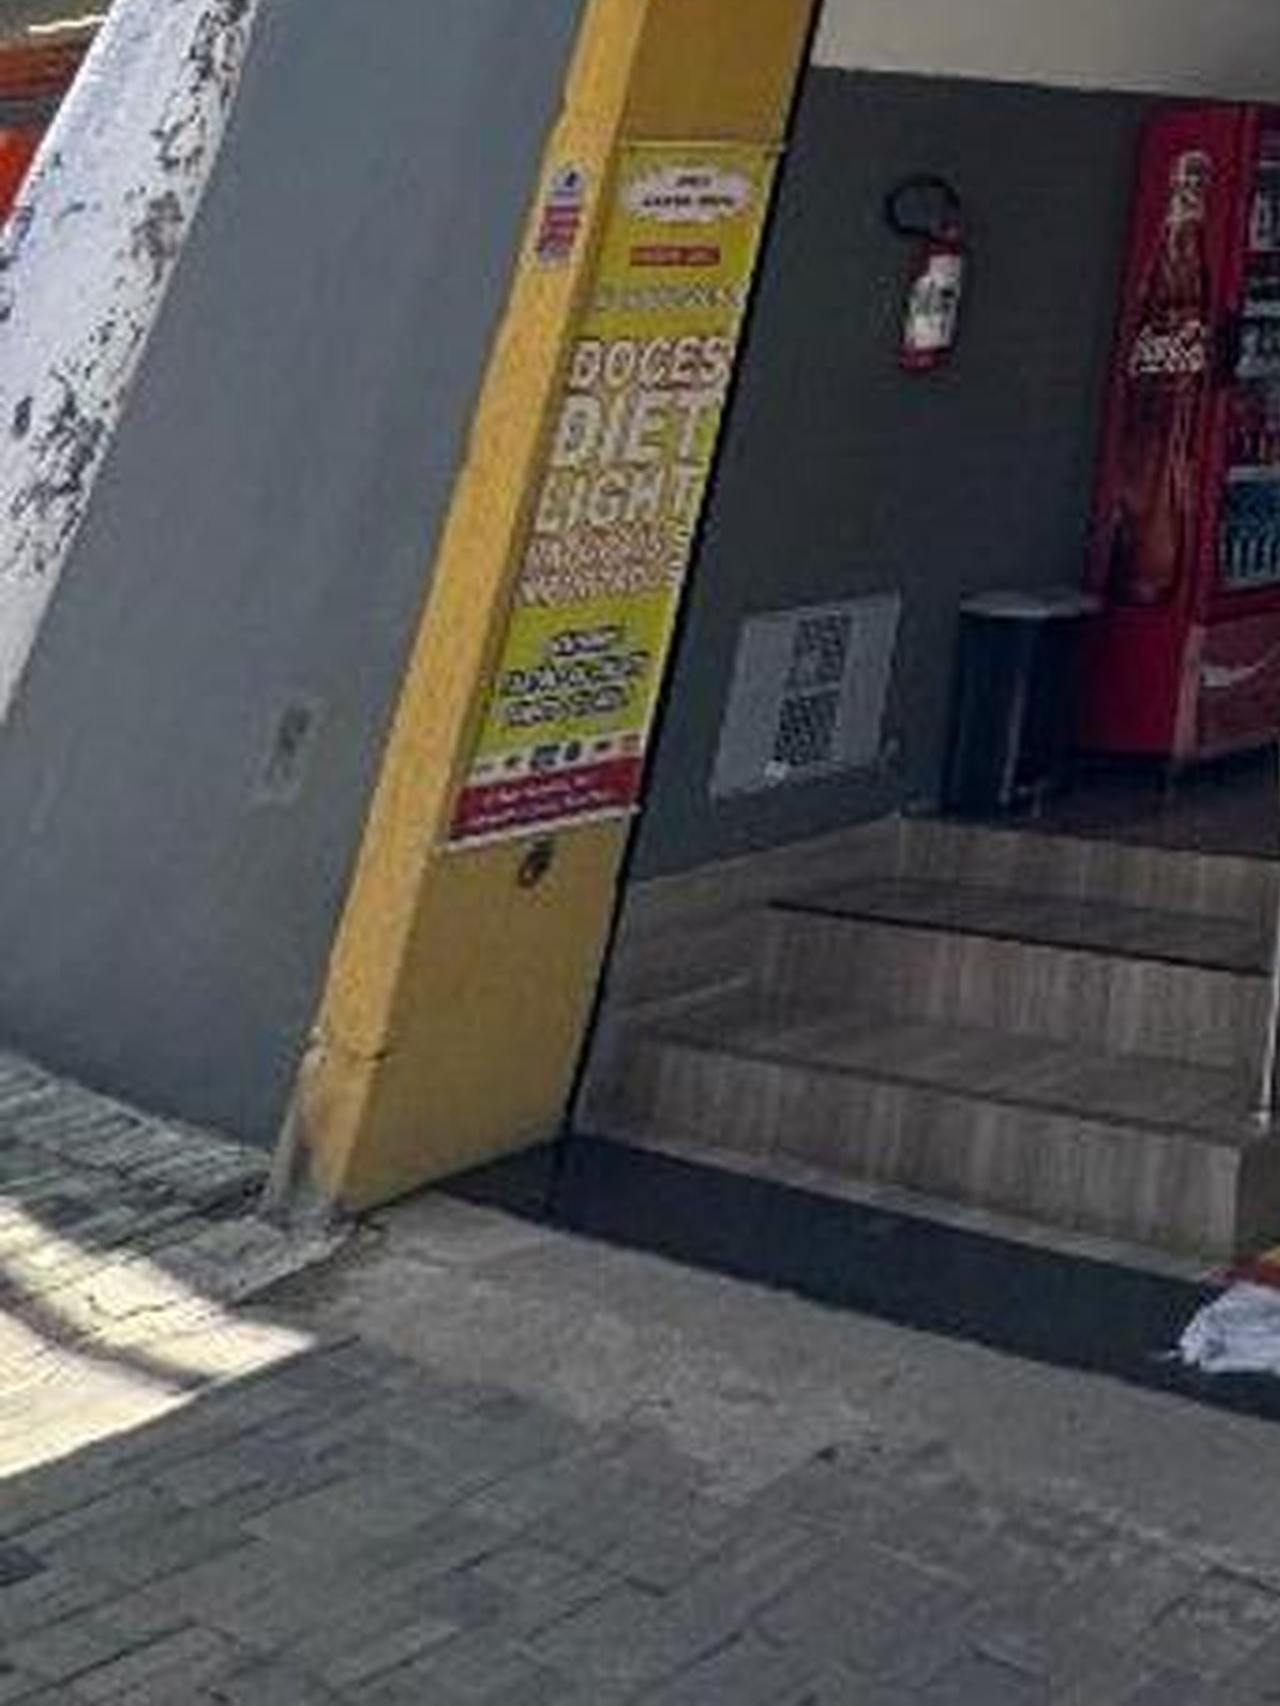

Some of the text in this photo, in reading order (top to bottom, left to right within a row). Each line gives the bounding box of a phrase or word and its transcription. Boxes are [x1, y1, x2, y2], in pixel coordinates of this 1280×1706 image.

[570, 336, 731, 389] DOCES
[552, 386, 724, 466] DIET
[536, 463, 706, 531] LIGHT
